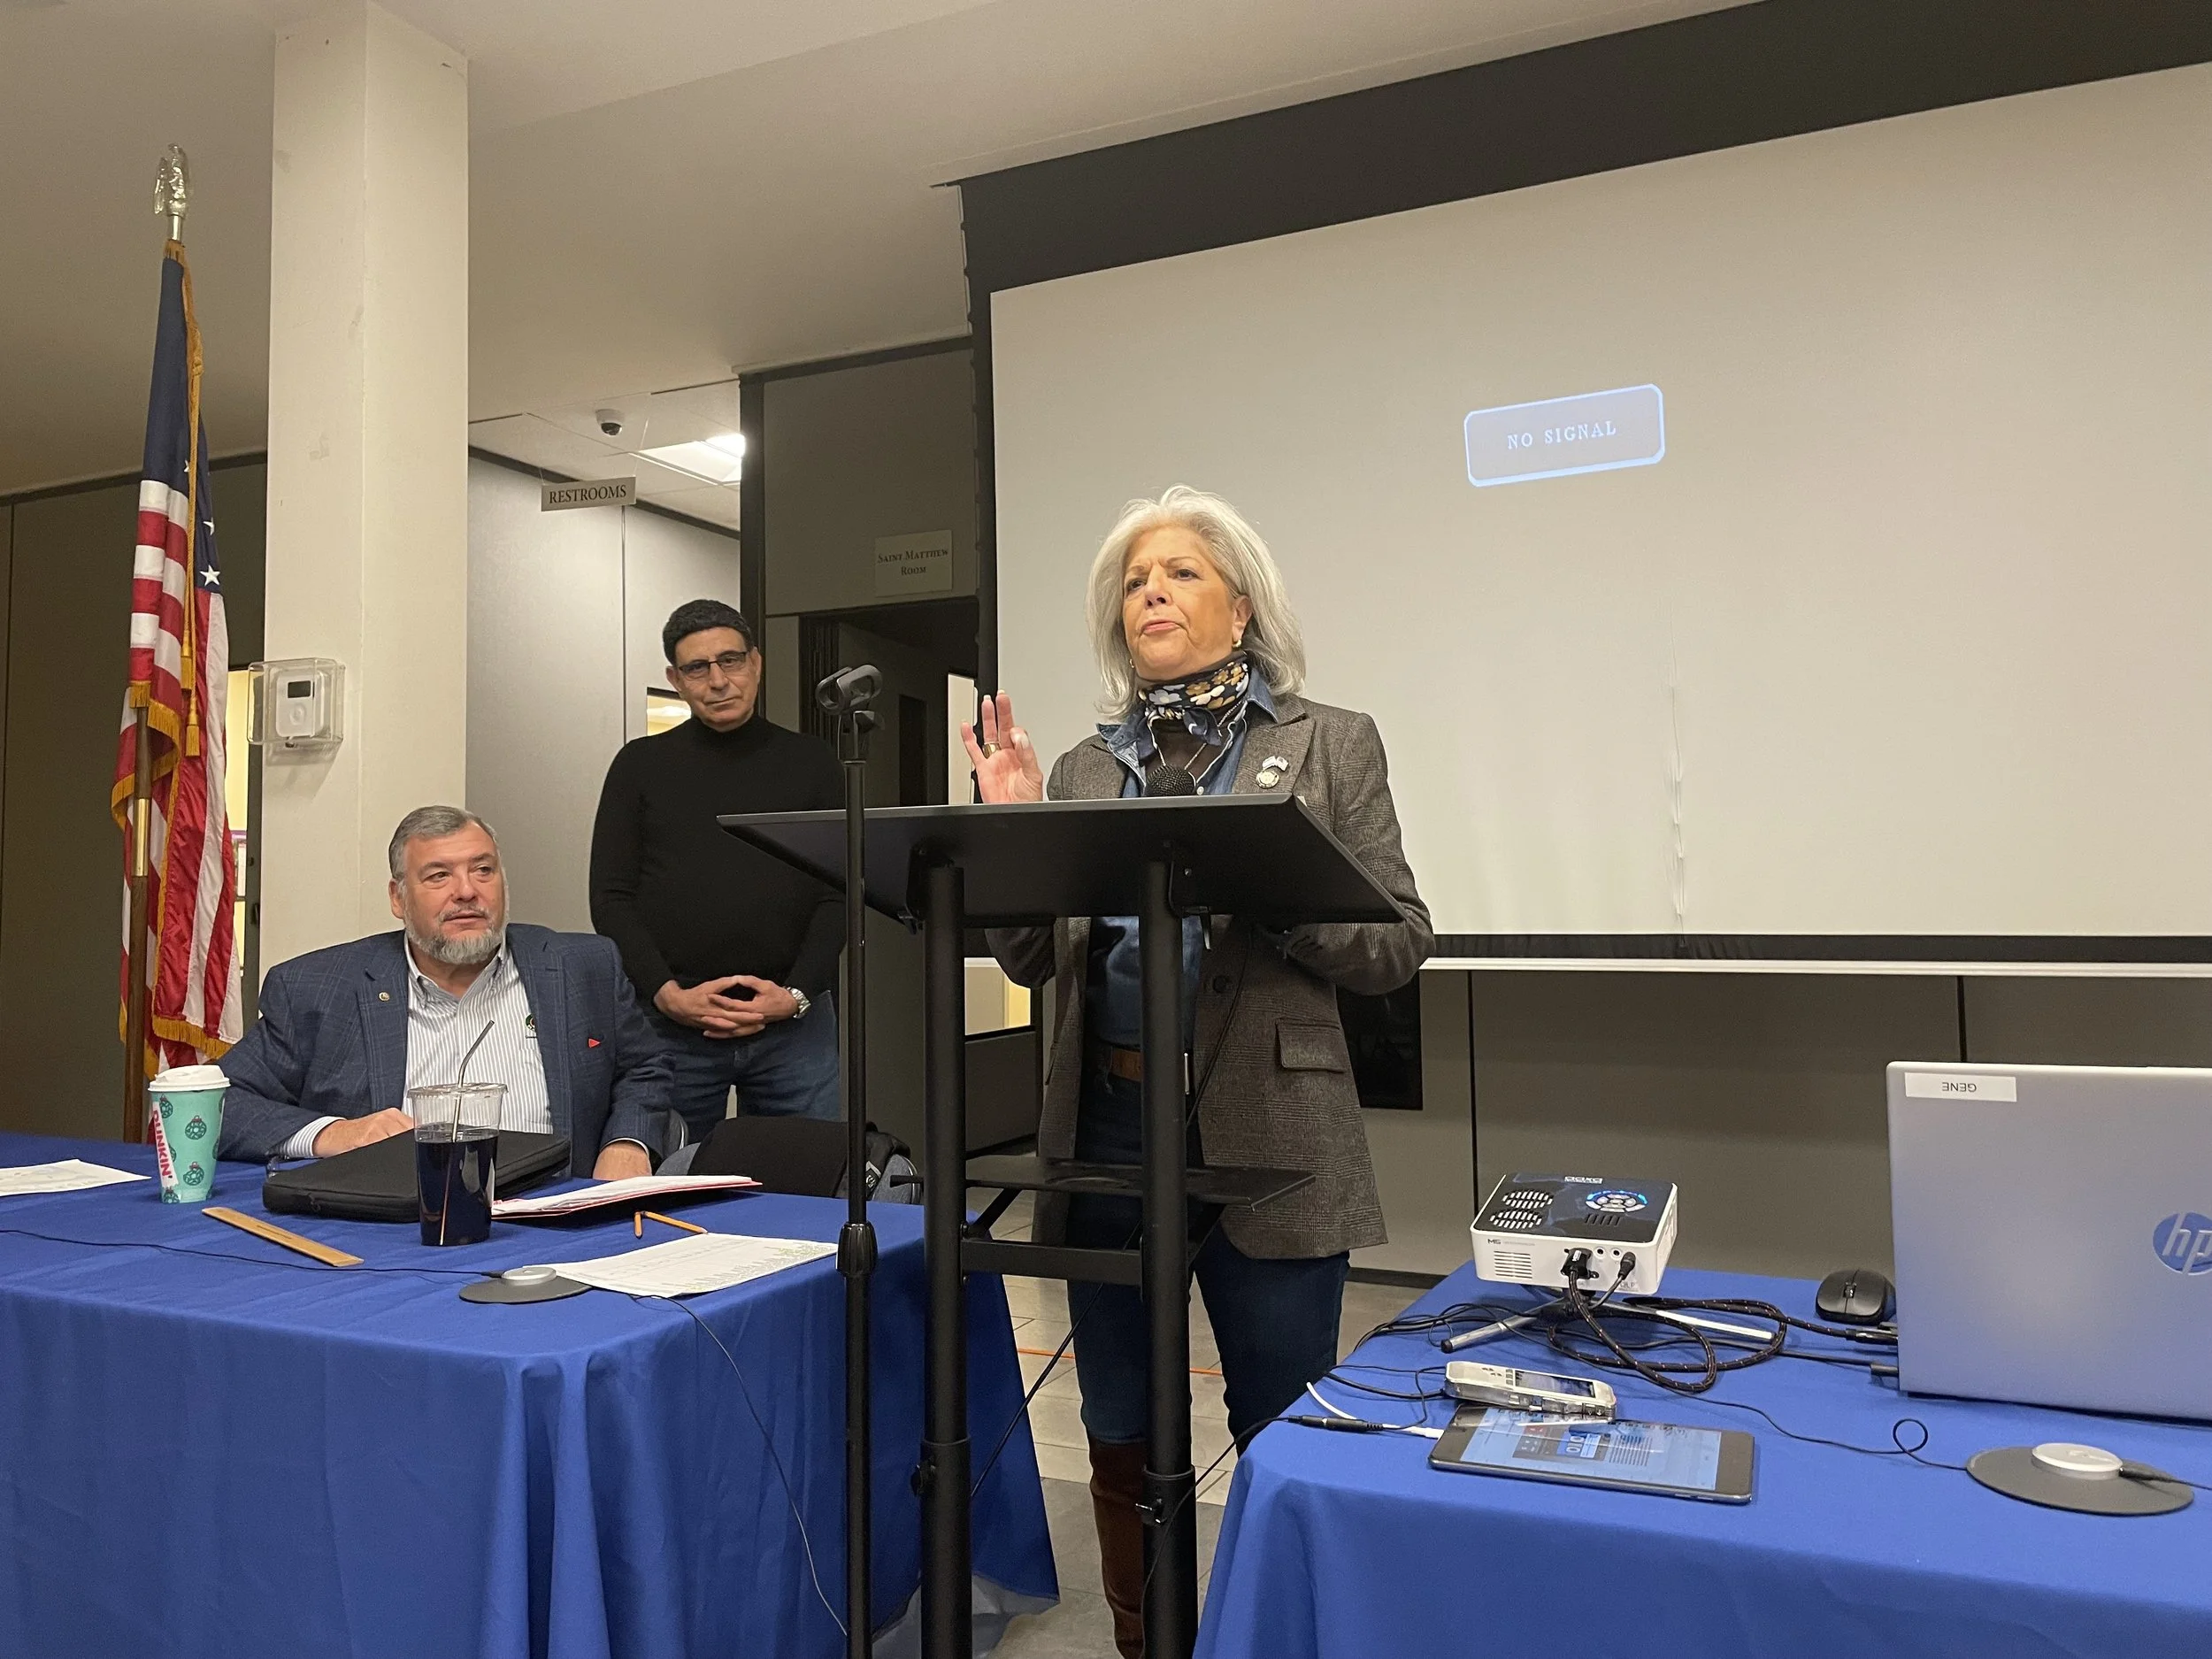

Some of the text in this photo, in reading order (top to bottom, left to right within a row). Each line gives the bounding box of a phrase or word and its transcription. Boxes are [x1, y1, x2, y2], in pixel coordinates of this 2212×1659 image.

[1507, 420, 1617, 449] NO SIGNAL
[549, 484, 626, 503] RESTROOMS
[1941, 1081, 1978, 1093] GENE
[153, 1110, 173, 1179] DUNKIN'
[2162, 1212, 2212, 1275] hp
